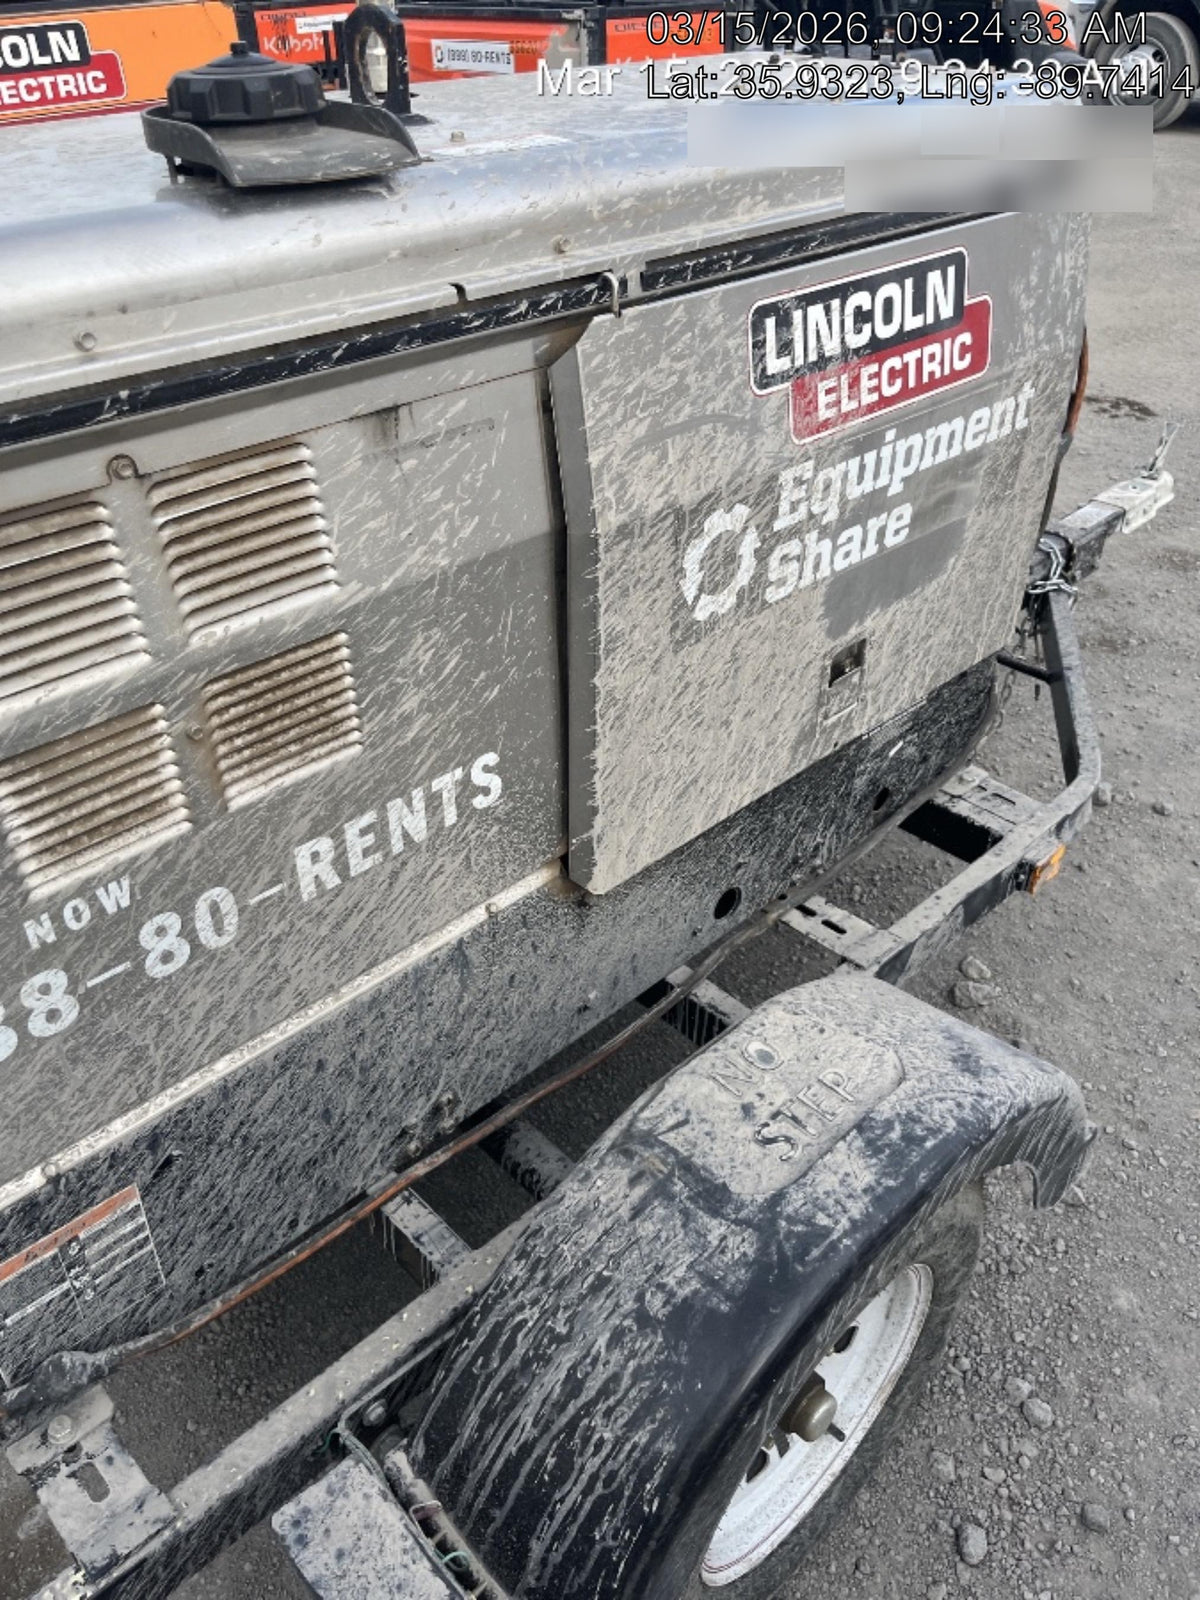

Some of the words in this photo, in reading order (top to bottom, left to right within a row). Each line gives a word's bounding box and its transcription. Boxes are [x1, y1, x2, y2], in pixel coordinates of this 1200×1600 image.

[0, 30, 81, 68] OLN
[0, 70, 107, 105] ECTRIC
[765, 264, 957, 376] LINCOLN
[817, 332, 972, 422] ELECTRIC
[773, 382, 1035, 532] Equipment
[765, 502, 913, 604] Share
[0, 751, 502, 1062] 8-80-RENTS
[23, 875, 132, 950] NOW
[709, 1039, 784, 1097] NO
[754, 1069, 854, 1162] STEP
